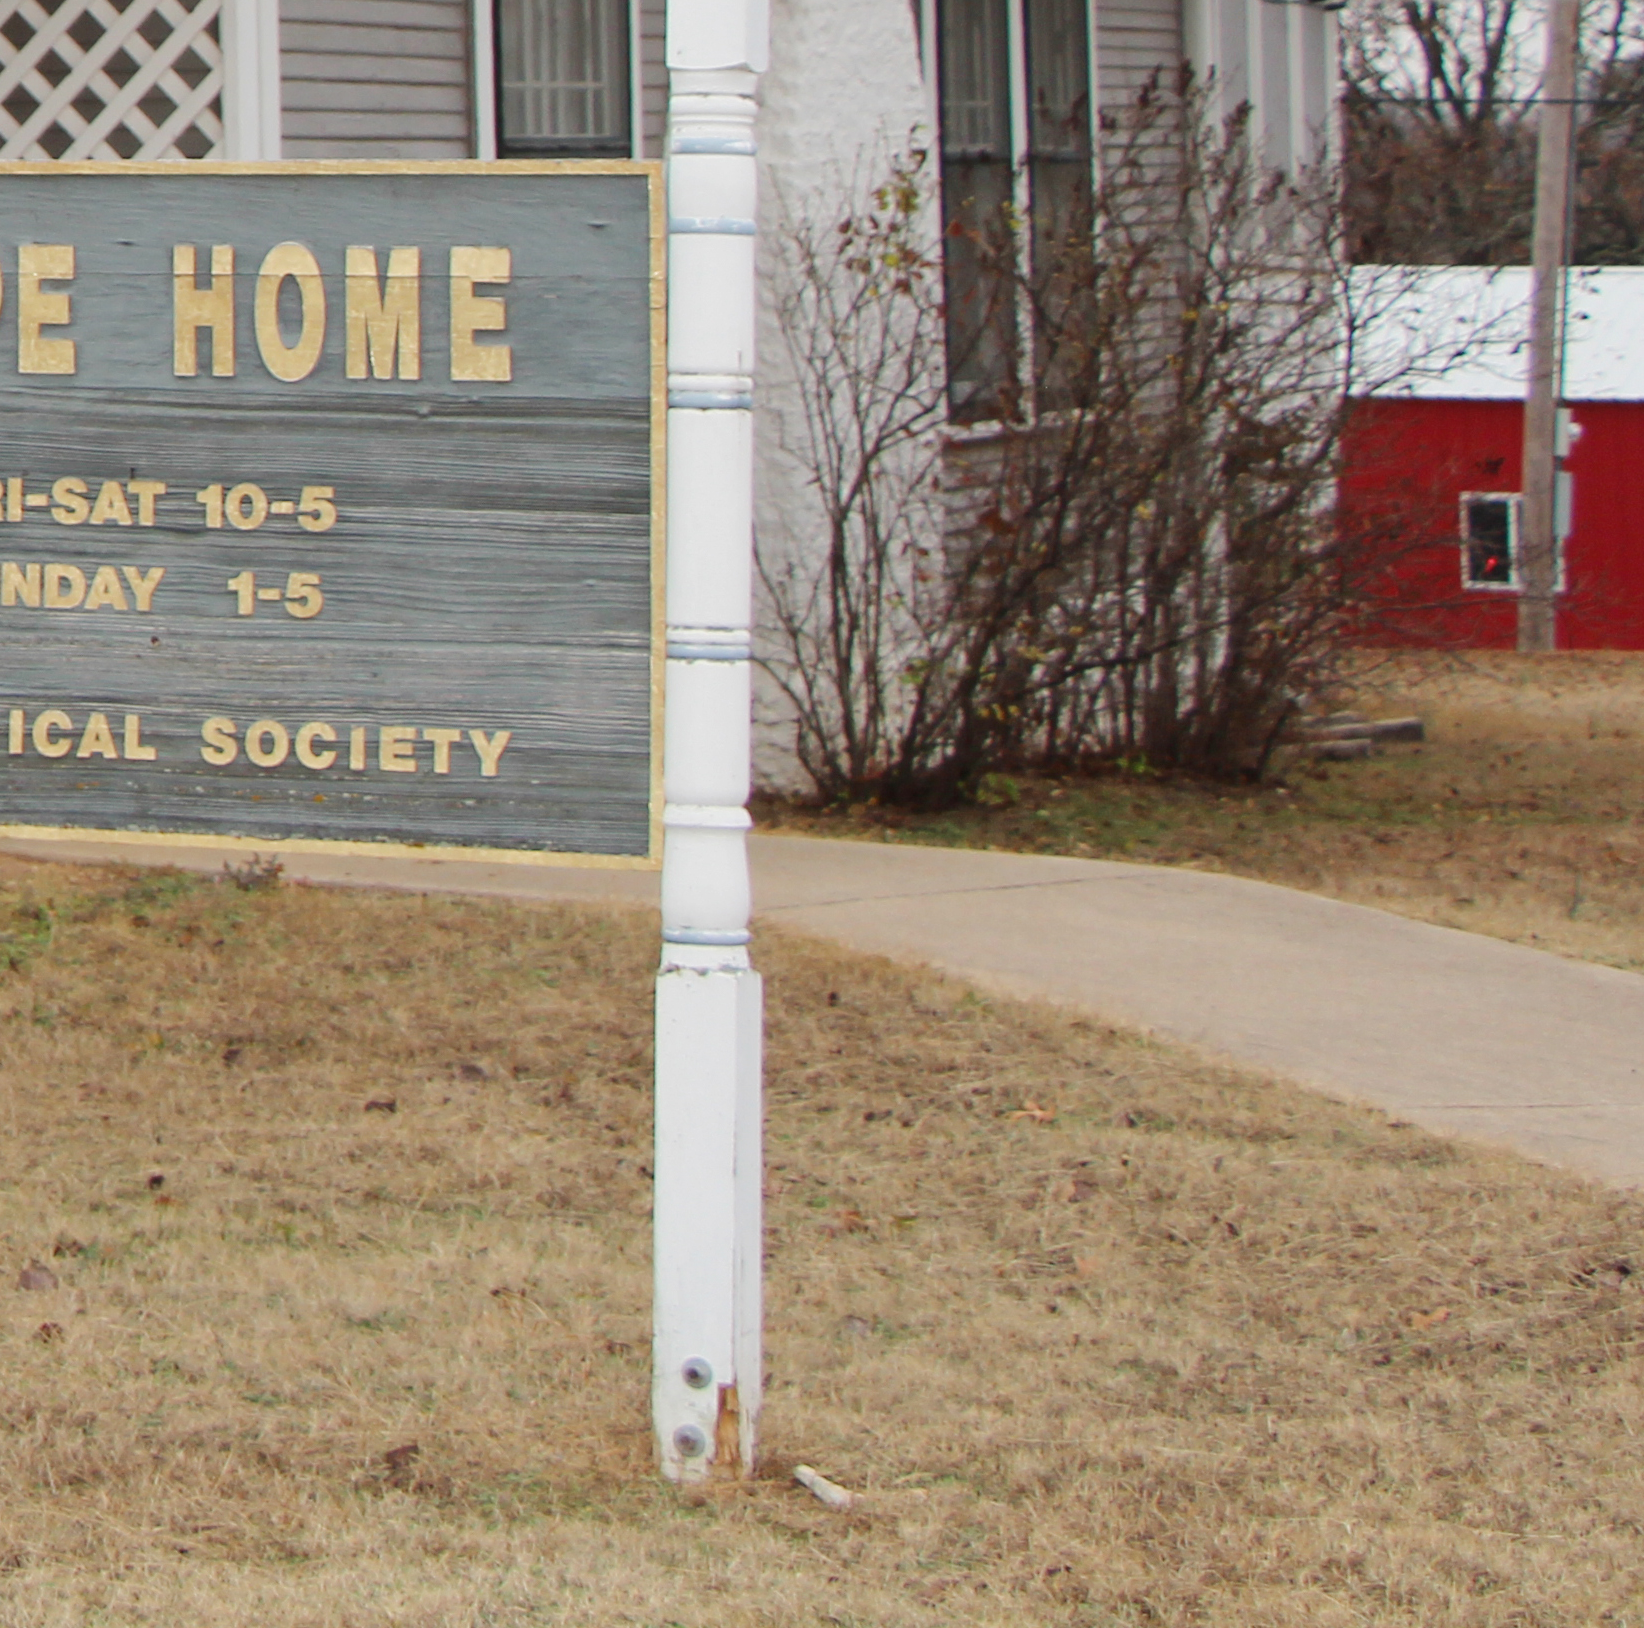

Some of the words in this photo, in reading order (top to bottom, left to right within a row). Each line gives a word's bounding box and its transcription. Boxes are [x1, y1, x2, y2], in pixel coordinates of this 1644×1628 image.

[172, 243, 513, 382] HOME
[196, 482, 339, 532] 10-5
[228, 570, 325, 619] 1-5
[200, 716, 513, 778] SOCIETY
